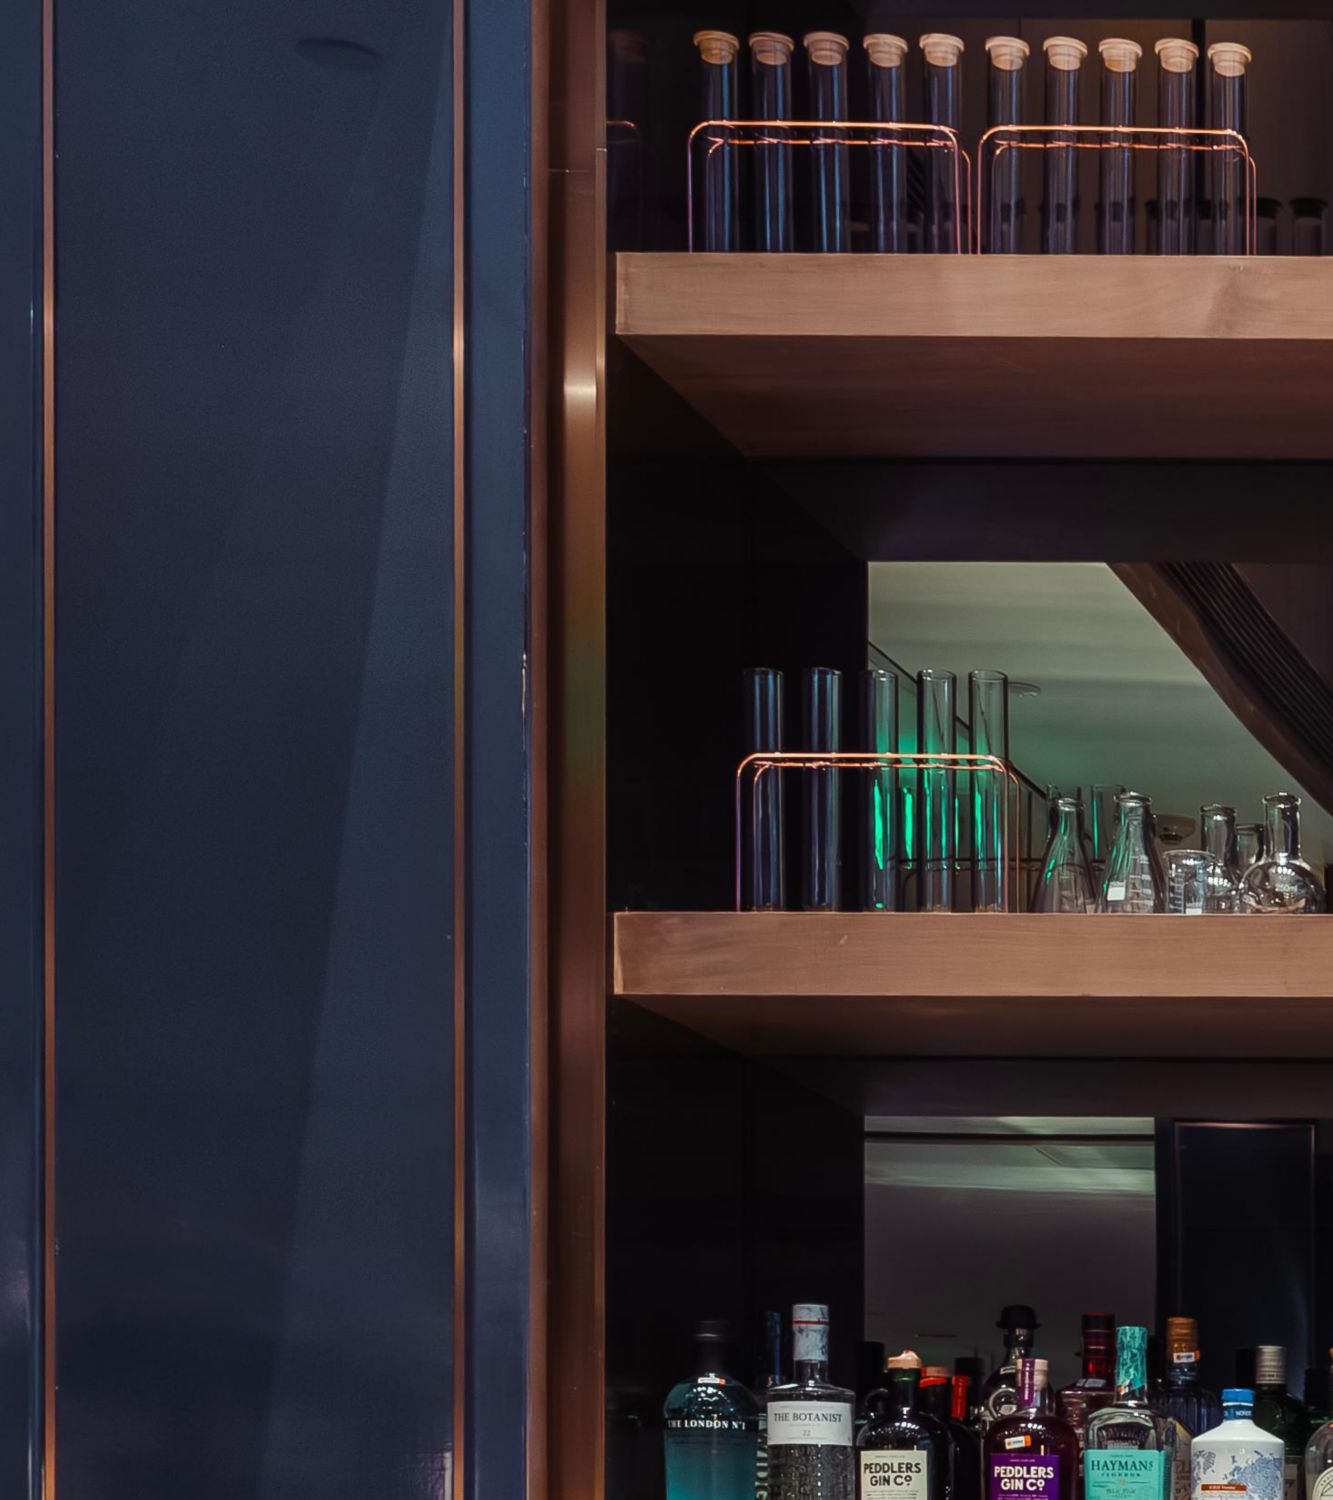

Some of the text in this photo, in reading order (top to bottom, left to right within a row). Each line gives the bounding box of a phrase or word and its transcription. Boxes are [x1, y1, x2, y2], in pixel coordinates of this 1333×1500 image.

[774, 1412, 842, 1422] THE BOTANIST
[667, 1418, 682, 1428] THE
[684, 1418, 729, 1429] LONDON
[864, 1462, 922, 1474] PEDDLERS
[994, 1466, 1054, 1478] PEDDLERS
[870, 1475, 891, 1486] GIN
[1000, 1478, 1024, 1490] GIN
